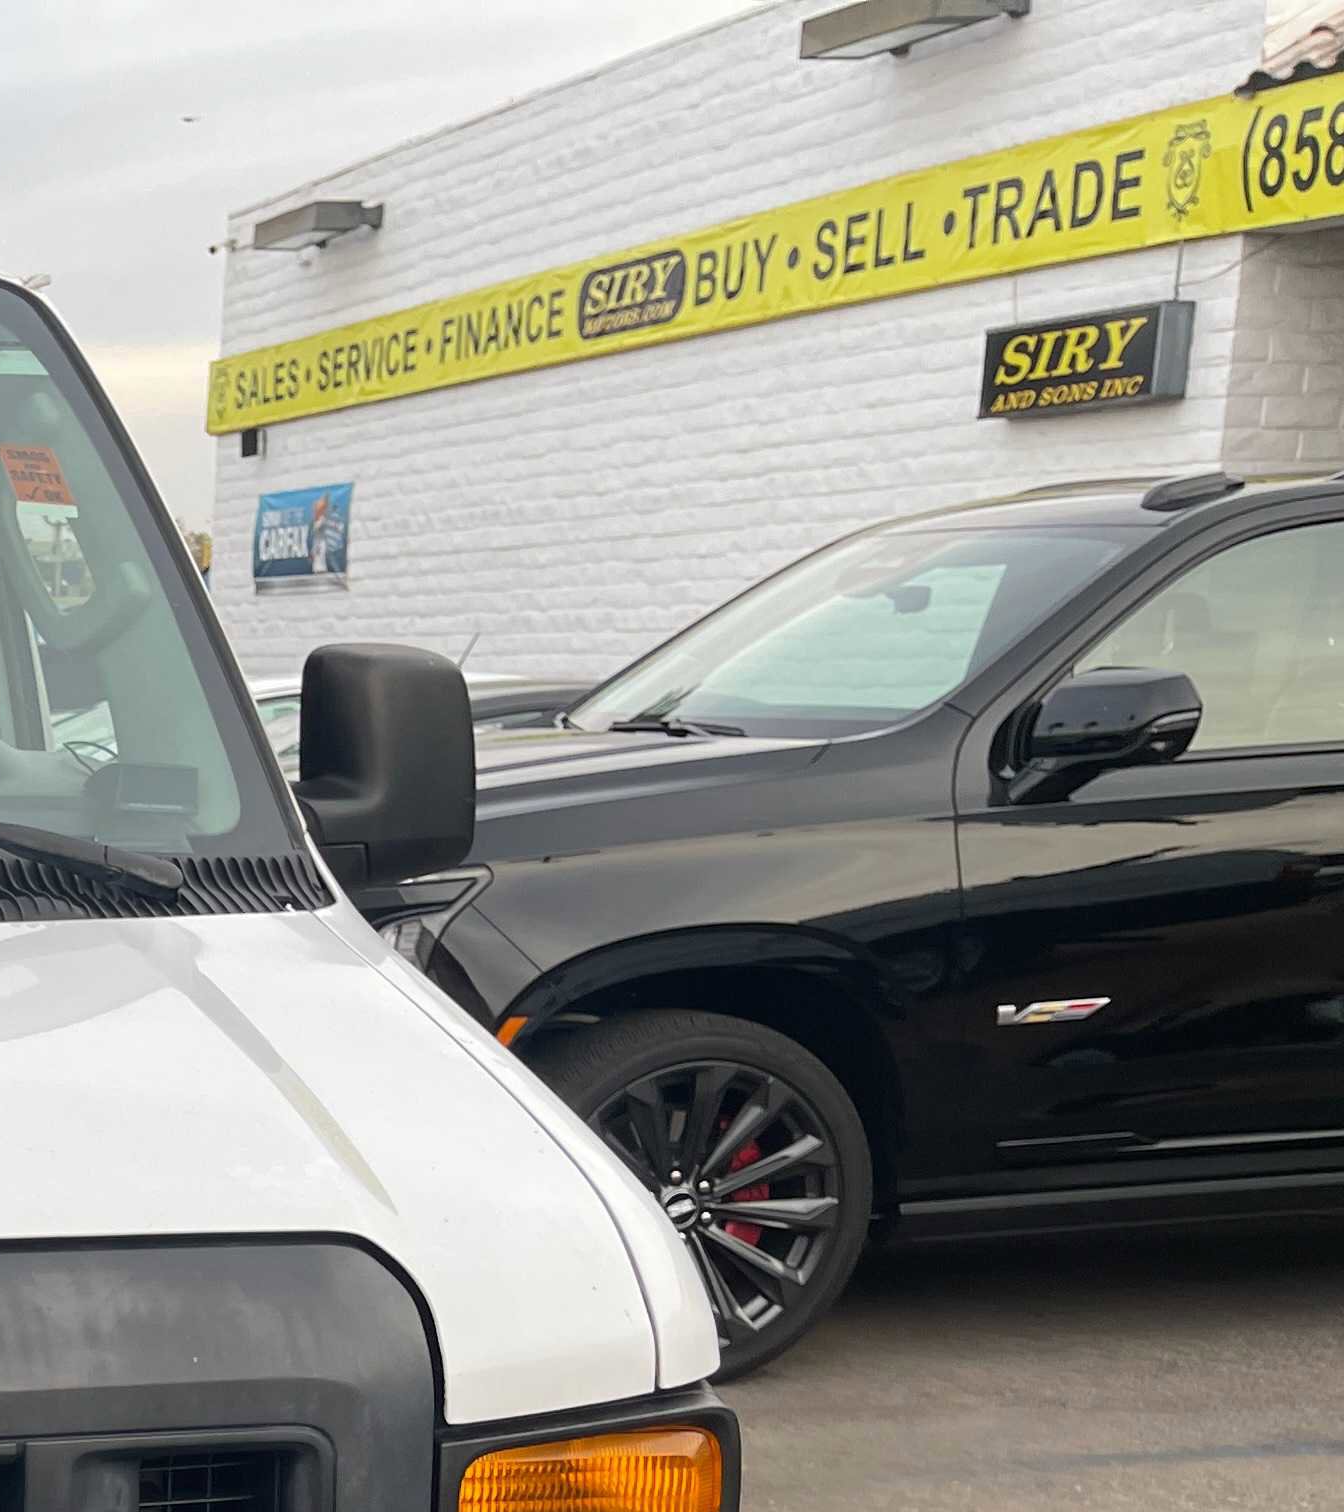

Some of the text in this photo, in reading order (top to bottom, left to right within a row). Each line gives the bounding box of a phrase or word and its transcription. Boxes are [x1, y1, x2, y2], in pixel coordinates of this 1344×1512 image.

[694, 148, 1147, 307] BUY SELL TRADE
[584, 254, 682, 317] SIRY
[235, 289, 567, 410] SALES SERVICE FINANCE
[994, 315, 1150, 387] SIRY
[990, 374, 1145, 413] AND SONS INC
[258, 526, 309, 561] CARFAX
